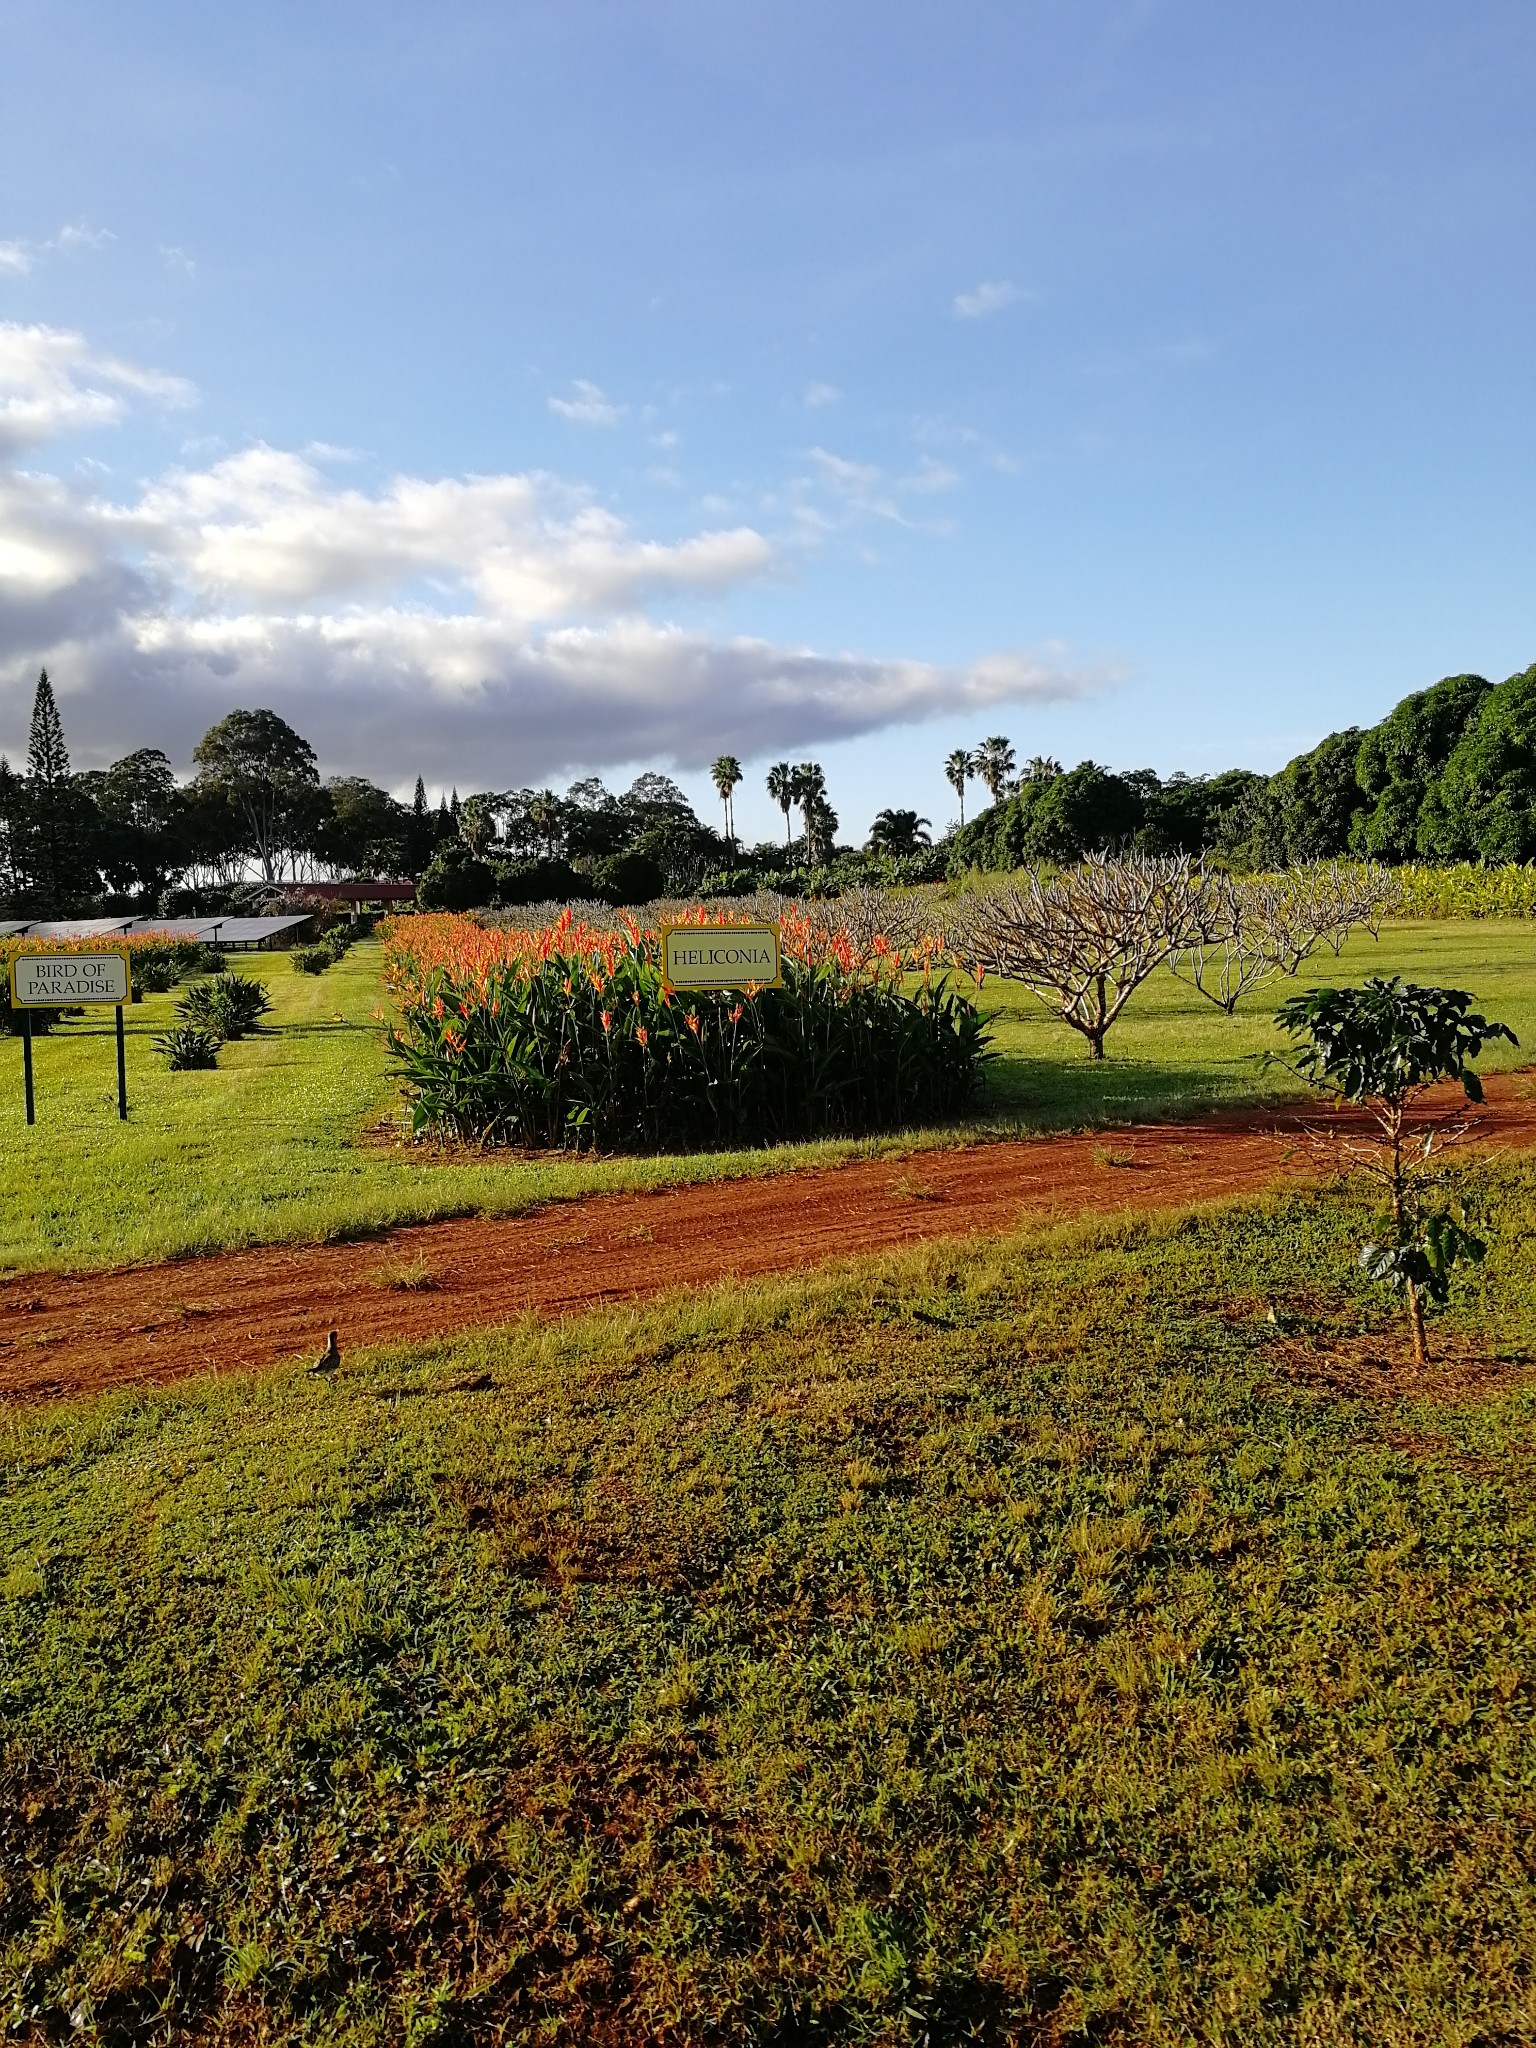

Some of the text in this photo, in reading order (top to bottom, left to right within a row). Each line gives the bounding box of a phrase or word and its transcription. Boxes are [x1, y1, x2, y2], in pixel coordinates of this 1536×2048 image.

[673, 948, 771, 965] HELICONIA
[36, 963, 106, 978] BIRD OF
[27, 980, 115, 994] PARADISE
